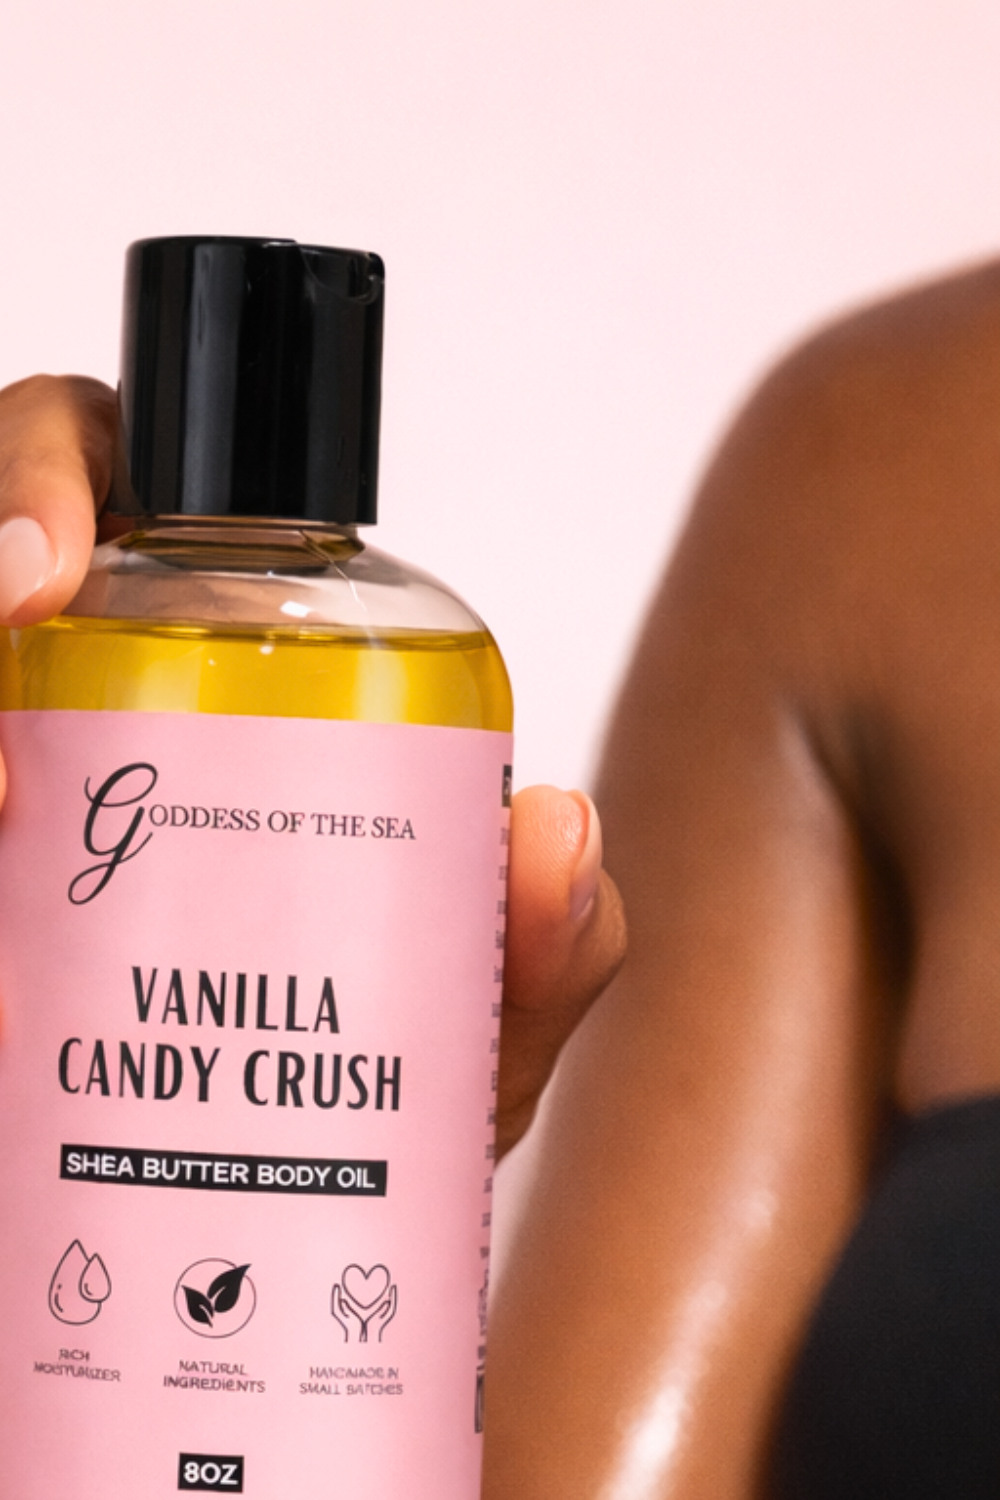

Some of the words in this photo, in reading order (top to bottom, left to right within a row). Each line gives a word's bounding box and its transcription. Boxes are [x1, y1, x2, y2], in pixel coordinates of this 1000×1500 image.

[68, 762, 260, 905] GODDESS
[267, 809, 306, 834] OF
[310, 812, 366, 838] THE
[370, 816, 417, 841] SEA
[131, 966, 341, 1034] VANILLA
[58, 1037, 221, 1103] CANDY
[243, 1049, 402, 1112] CRUSH
[66, 1151, 135, 1178] SHEA
[142, 1157, 249, 1185] BUTTER
[257, 1163, 332, 1188] BODY
[336, 1166, 376, 1189] OIL
[58, 1348, 90, 1362] RICH
[178, 1359, 248, 1376] NATURAL
[183, 1461, 239, 1486] 8OZ
